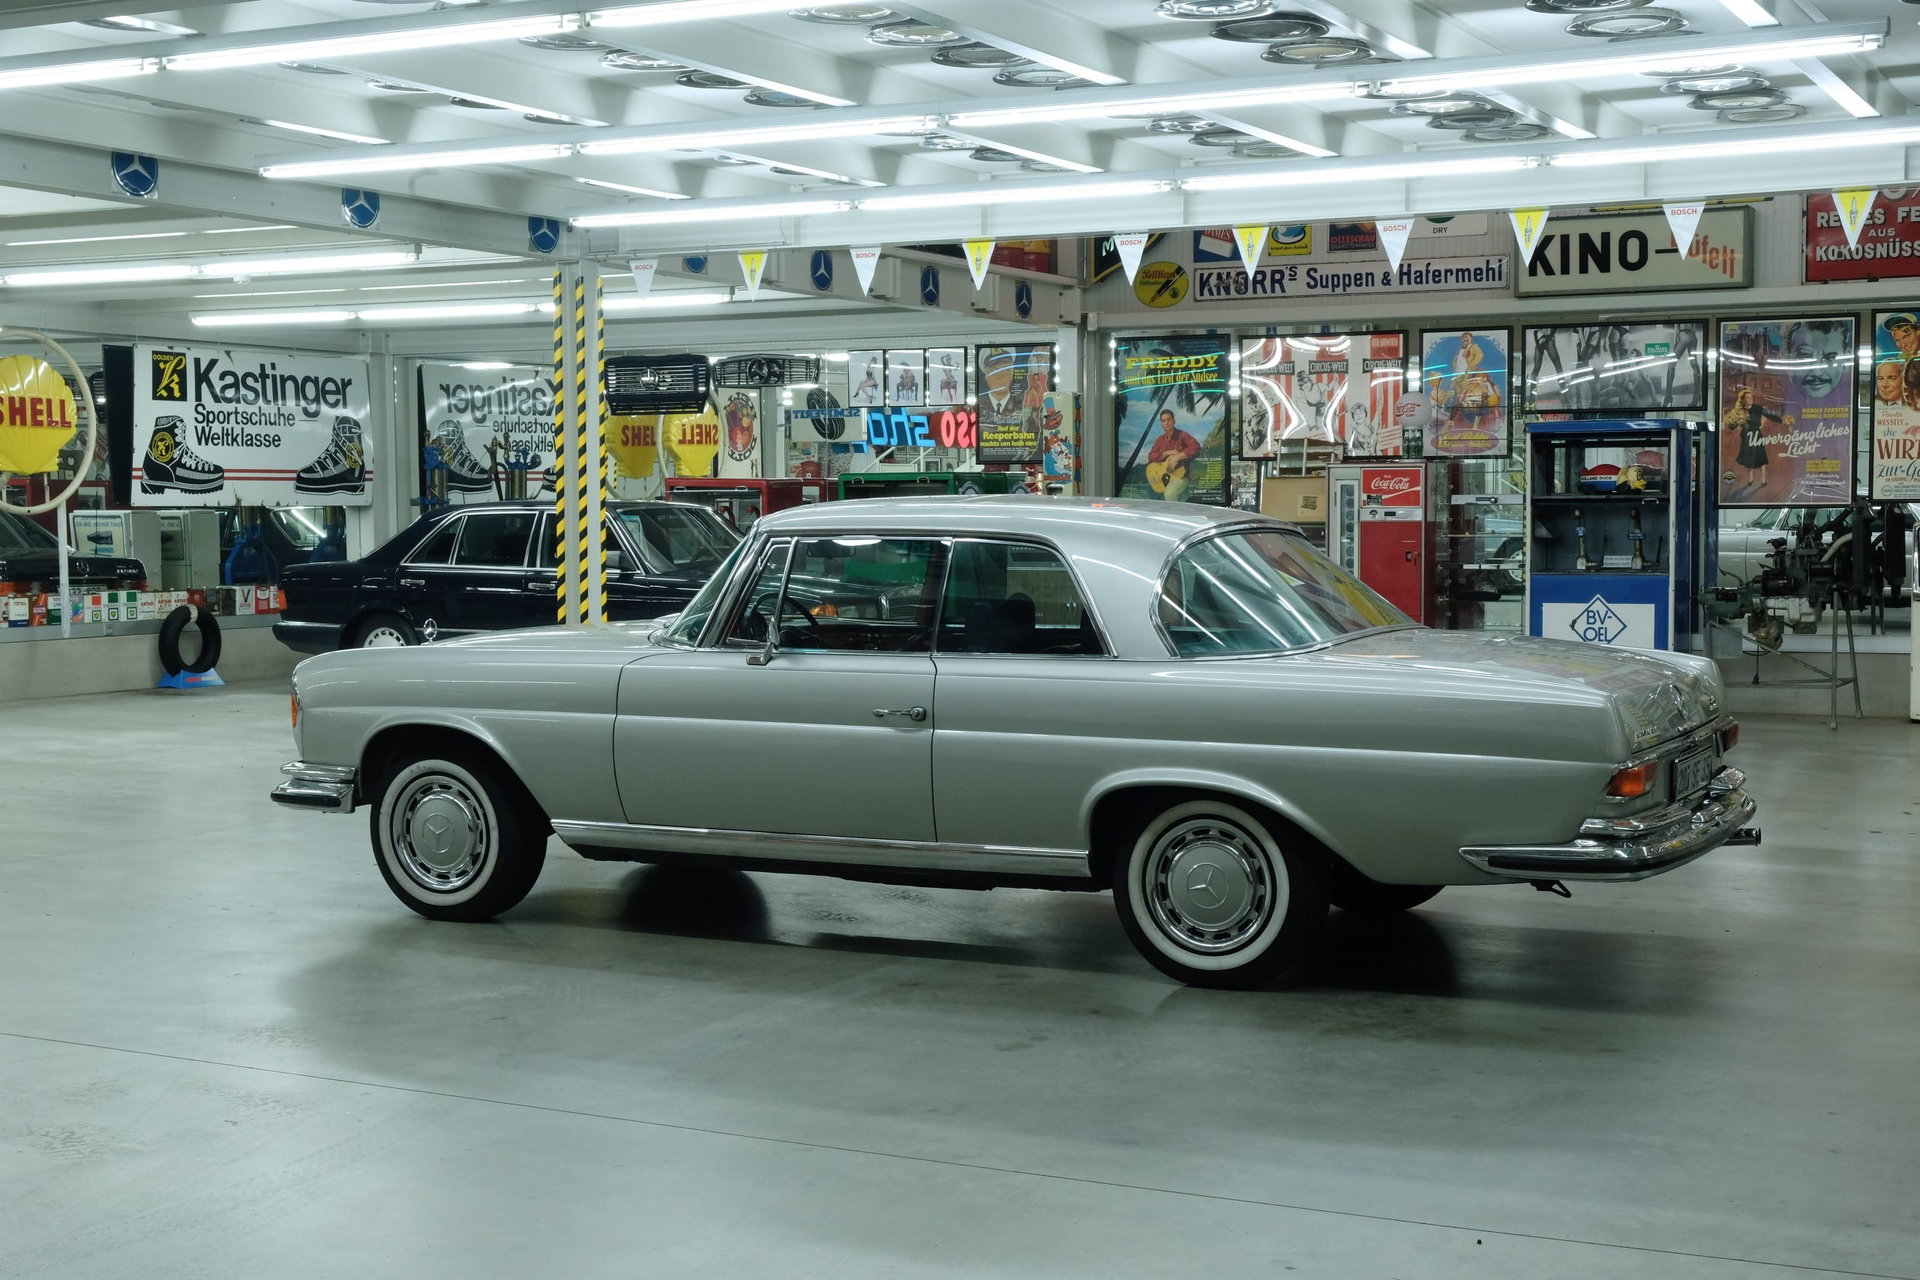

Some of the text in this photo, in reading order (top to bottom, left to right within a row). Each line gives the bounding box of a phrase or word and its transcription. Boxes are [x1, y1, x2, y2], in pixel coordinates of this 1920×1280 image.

[1670, 208, 1698, 216] BOSCH
[1383, 224, 1407, 232] BOSCH
[1432, 226, 1449, 235] DRY
[1868, 228, 1896, 238] AUS
[1120, 239, 1142, 247] BOSCH
[1330, 233, 1376, 244] OLLESCHAU
[1306, 267, 1375, 292] Suppen
[1381, 270, 1392, 287] &
[1124, 355, 1219, 370] FREDDY
[1309, 361, 1348, 373] CIRCUS-WELT
[193, 357, 353, 418] Kastinger
[194, 402, 296, 427] Sportschuhe
[194, 426, 282, 448] Weltklasse
[983, 431, 1035, 442] Reeperbahn
[1746, 422, 1850, 447] Unvergängliches
[1778, 441, 1821, 458] Licht
[1371, 476, 1412, 490] Coca-Cola
[1586, 610, 1612, 625] BV-
[1583, 626, 1611, 642] OEL
